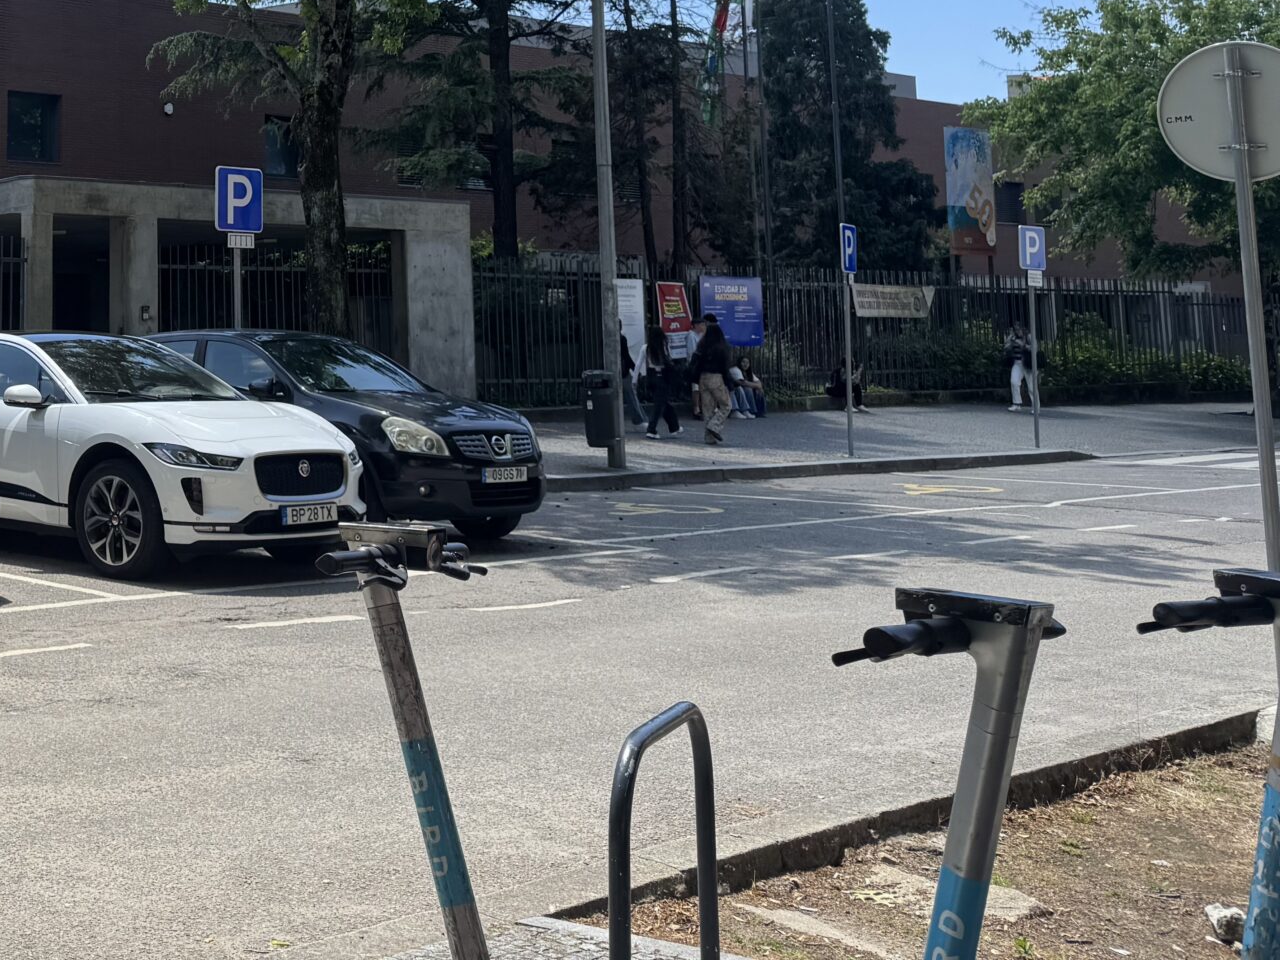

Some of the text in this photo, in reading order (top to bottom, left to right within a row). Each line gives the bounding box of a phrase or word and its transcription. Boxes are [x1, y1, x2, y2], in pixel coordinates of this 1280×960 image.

[1166, 115, 1195, 124] C.M.M.
[227, 174, 253, 224] P
[966, 183, 994, 234] 50
[844, 230, 854, 267] P
[1025, 231, 1040, 265] P
[714, 285, 738, 293] ESTUDAR
[739, 285, 748, 293] EM
[291, 505, 333, 523] BP28TX
